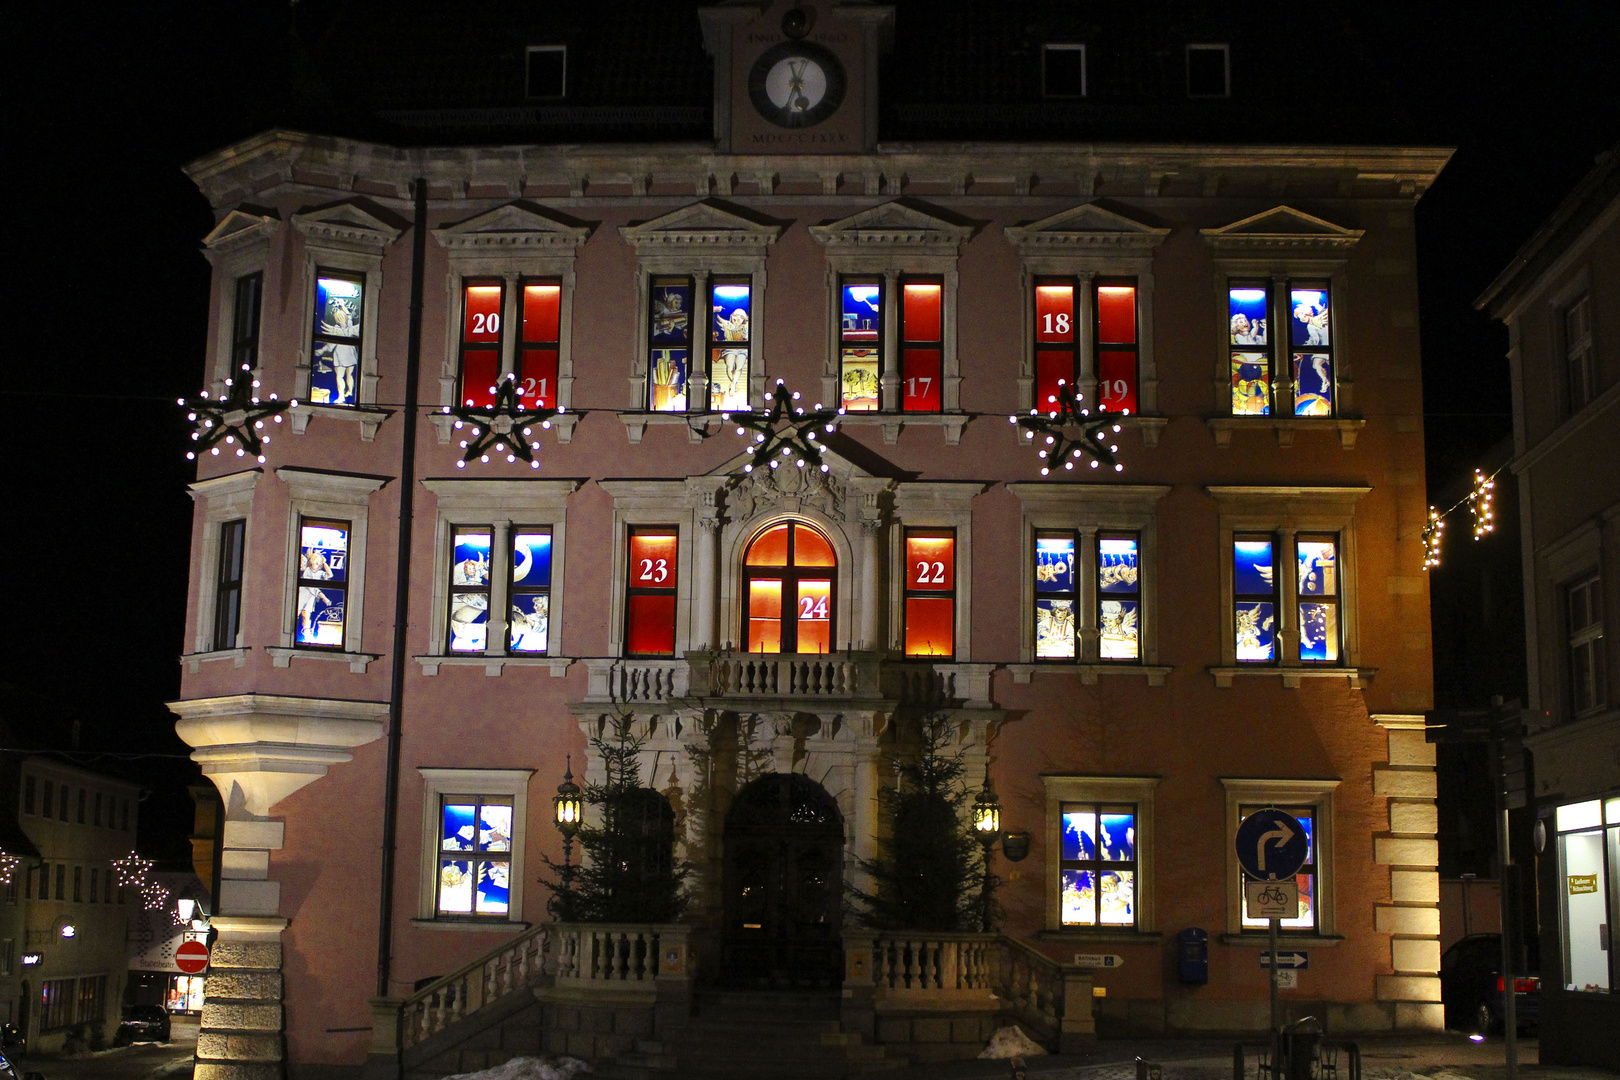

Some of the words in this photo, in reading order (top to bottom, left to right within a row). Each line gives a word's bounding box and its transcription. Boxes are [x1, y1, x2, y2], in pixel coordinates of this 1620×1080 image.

[472, 313, 499, 333] 20
[1043, 313, 1070, 334] 18
[524, 378, 548, 398] 21
[906, 377, 932, 399] 17
[1101, 379, 1128, 403] 19
[332, 556, 342, 567] 7
[640, 559, 668, 583] 23
[917, 562, 945, 584] 22
[800, 595, 828, 619] 24
